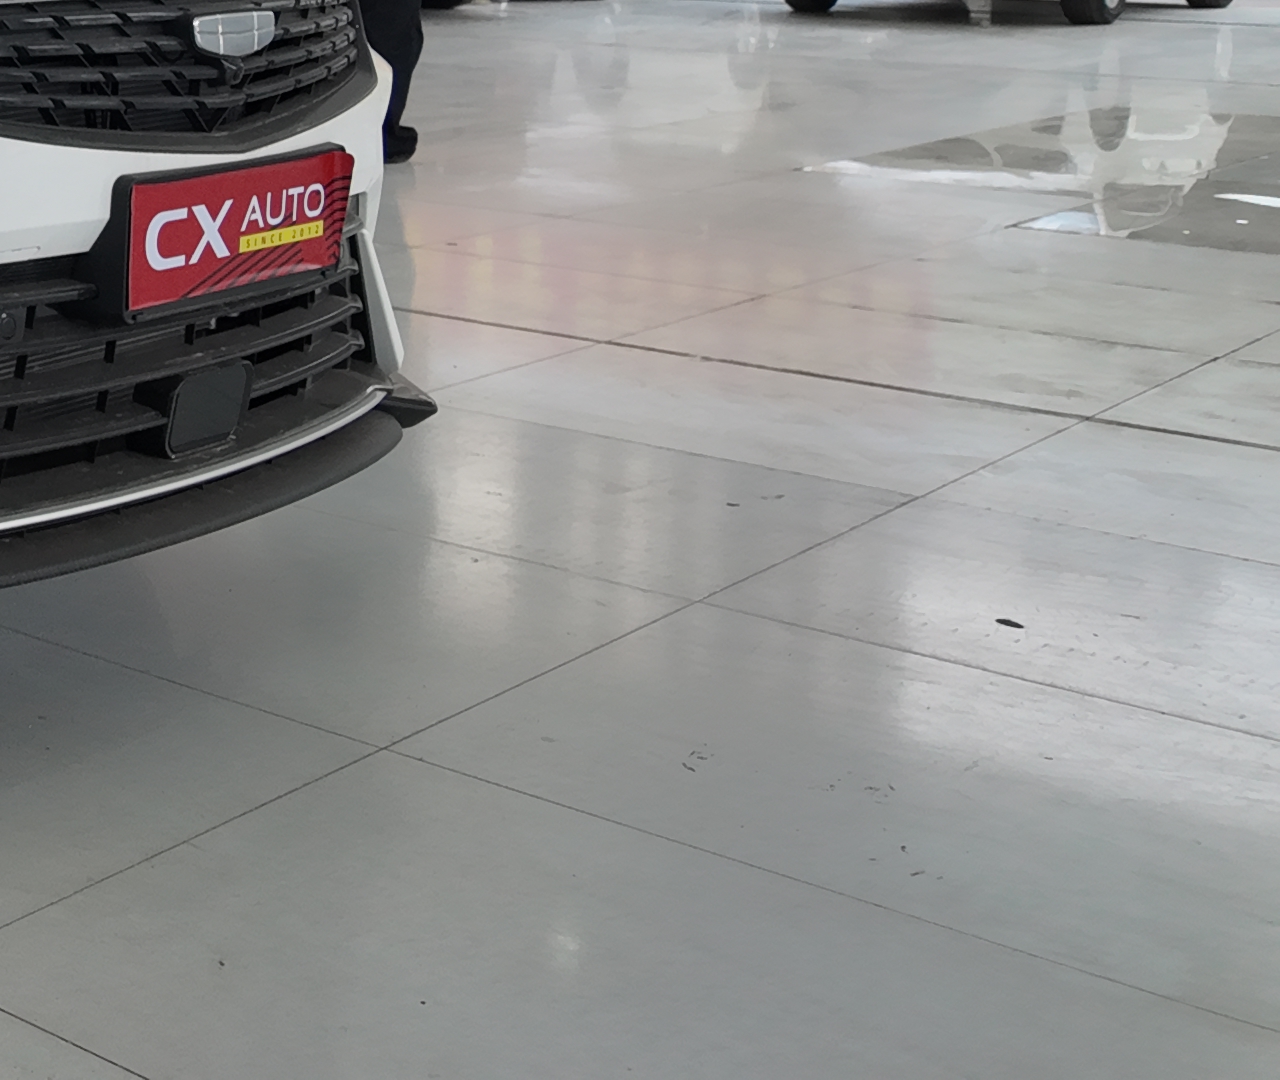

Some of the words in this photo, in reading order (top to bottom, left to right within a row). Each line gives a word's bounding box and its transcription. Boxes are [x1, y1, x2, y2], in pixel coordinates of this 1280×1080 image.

[145, 198, 234, 271] CX
[240, 183, 325, 232] AUTO
[246, 233, 283, 249] SINCE
[292, 224, 321, 240] 2012
